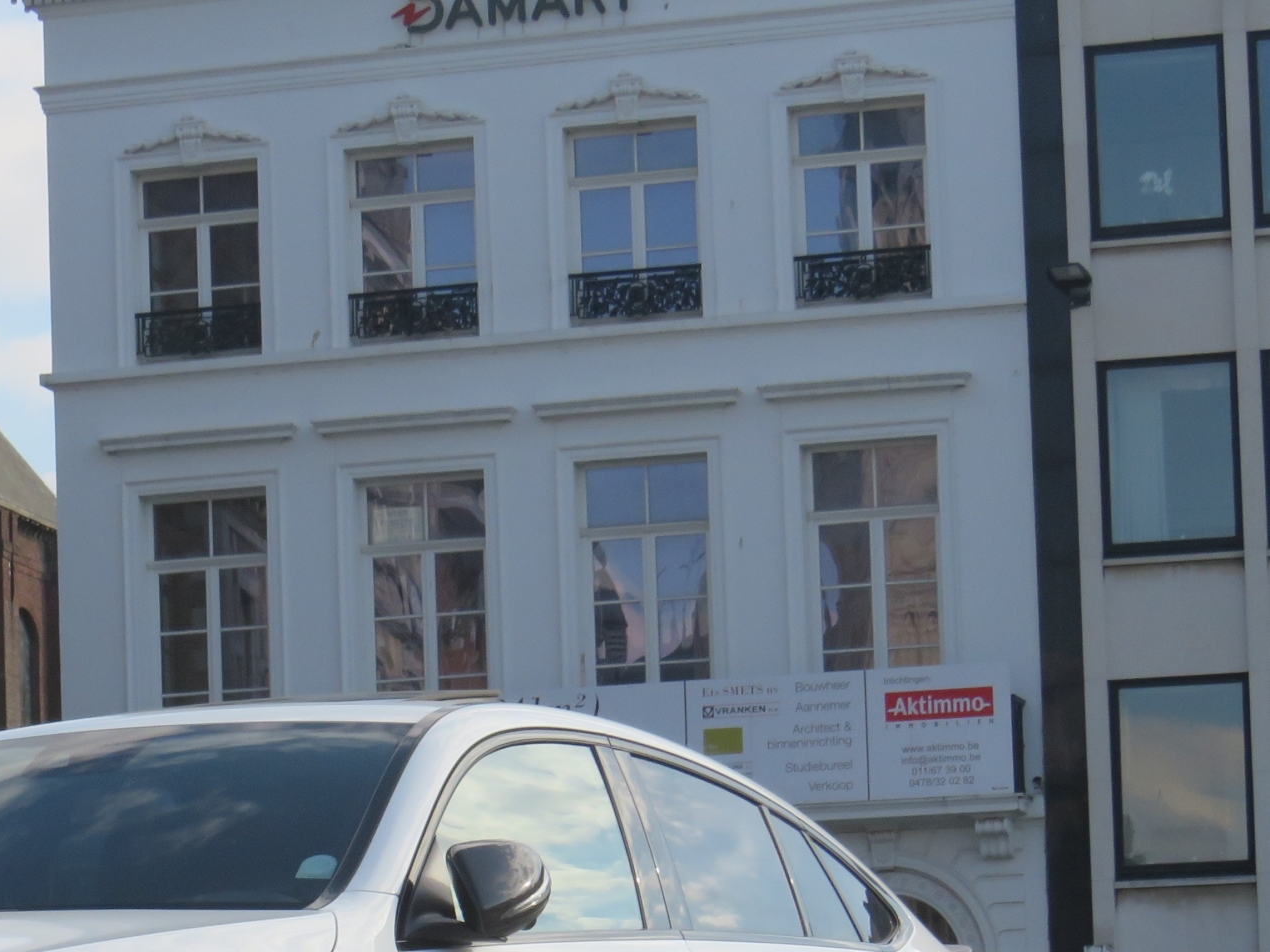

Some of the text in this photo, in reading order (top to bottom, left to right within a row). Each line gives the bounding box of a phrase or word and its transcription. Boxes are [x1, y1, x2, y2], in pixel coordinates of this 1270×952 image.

[723, 685, 764, 696] SMETS
[795, 680, 851, 693] Bouwheer
[714, 705, 766, 715] VRANKEN
[795, 701, 852, 713] Aannemer
[888, 695, 991, 717] Aktimmo
[792, 721, 853, 735] Architect &
[767, 735, 853, 750] binneninrichting
[902, 741, 980, 754] www.aktimmo.be
[901, 753, 982, 766] info@aktimmo.be
[808, 780, 854, 793] Verkoop
